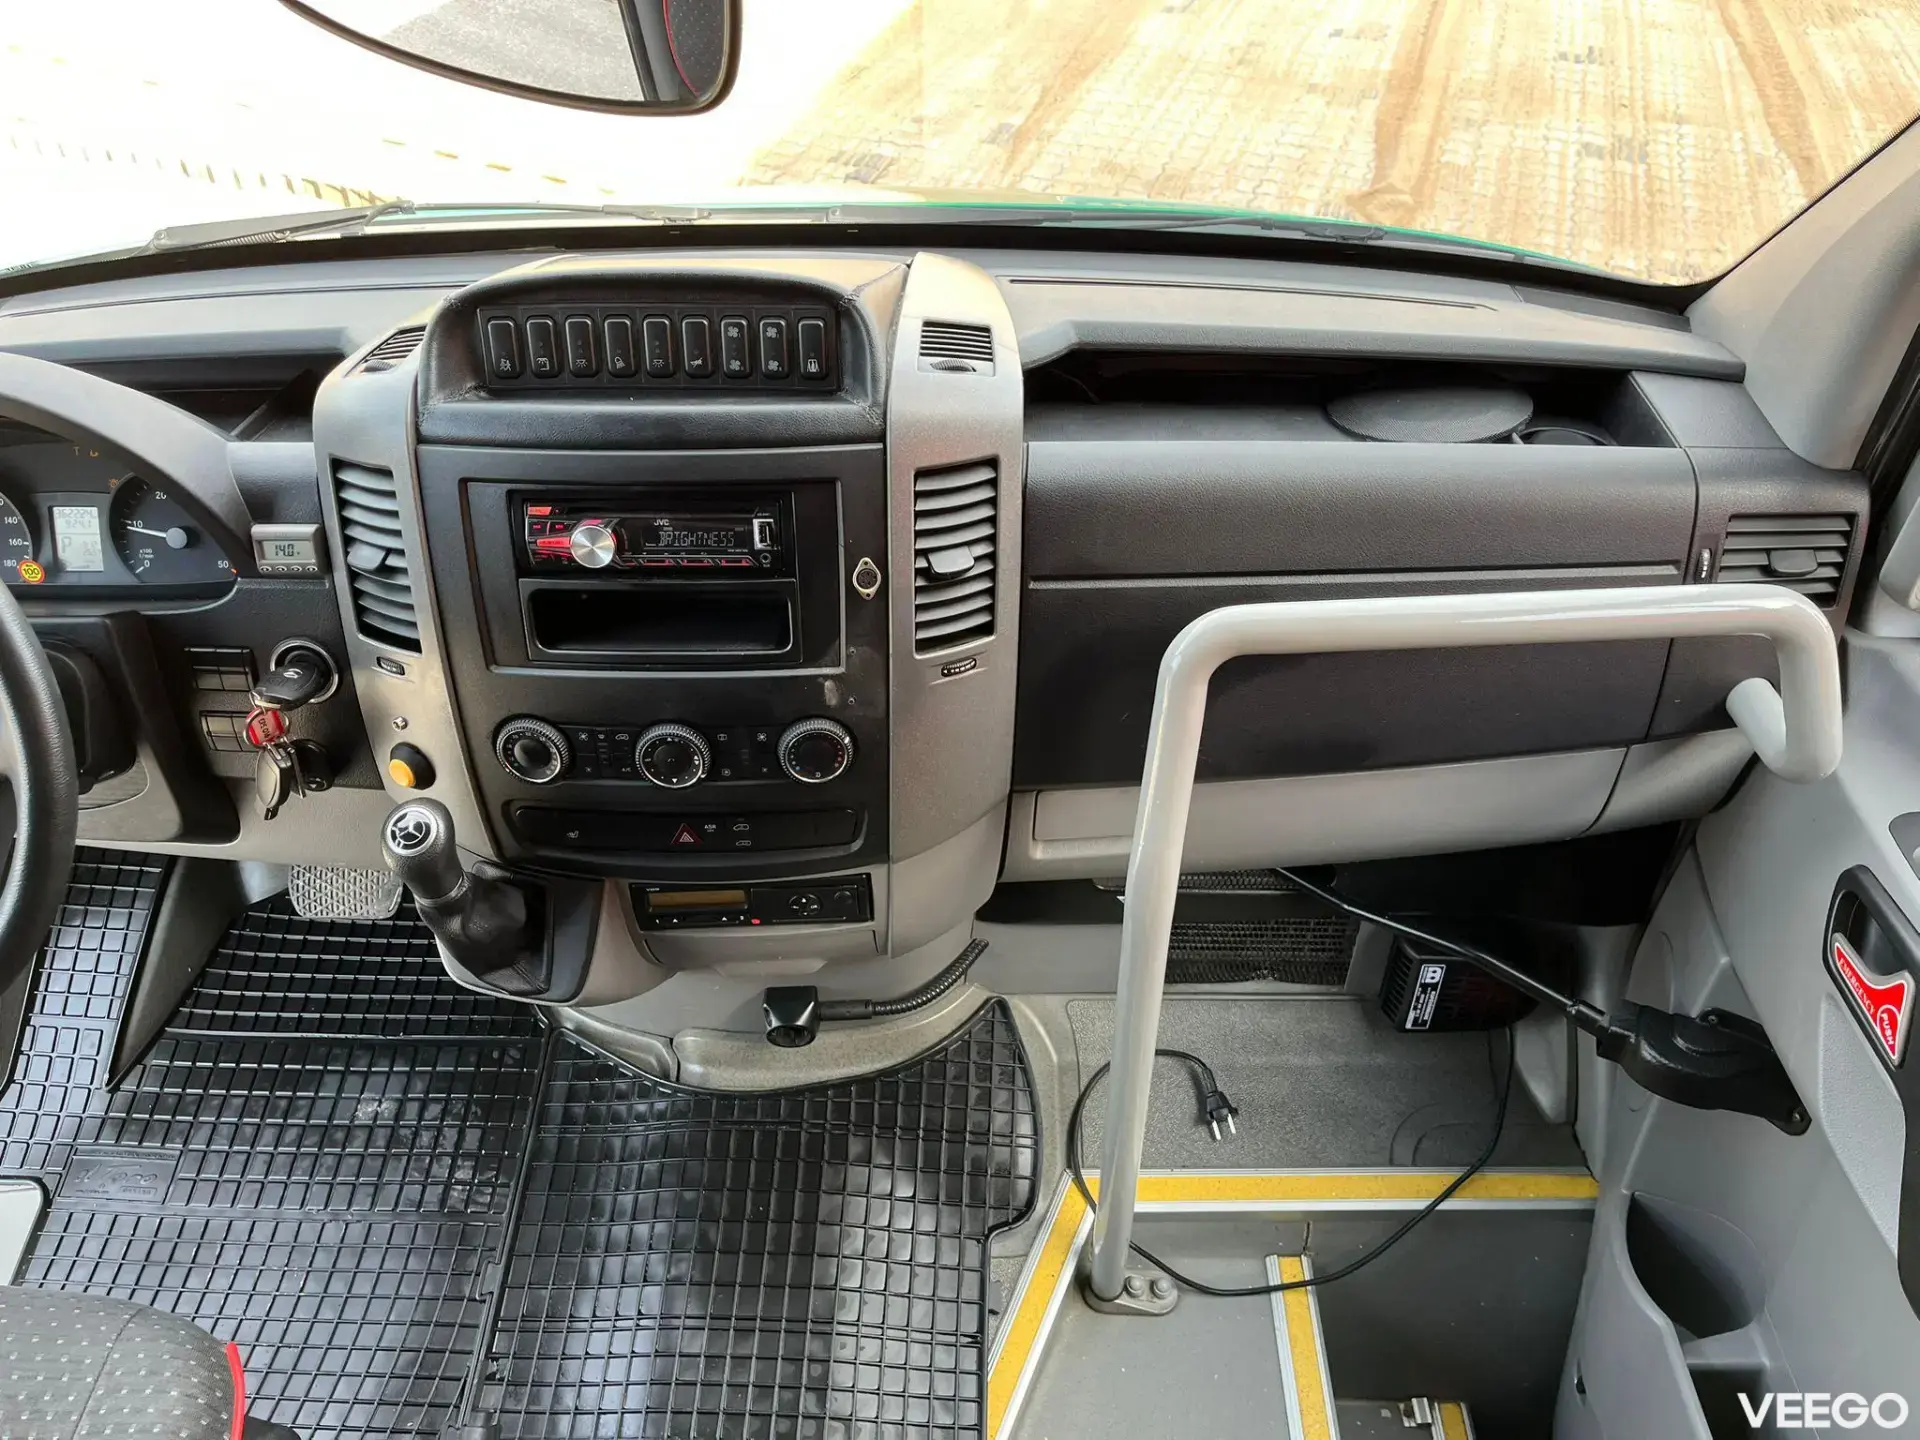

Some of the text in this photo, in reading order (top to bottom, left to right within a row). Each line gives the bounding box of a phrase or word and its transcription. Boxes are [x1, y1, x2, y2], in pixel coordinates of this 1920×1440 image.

[4, 516, 18, 525] 140
[132, 520, 143, 528] 10
[653, 518, 670, 526] JVC
[9, 538, 23, 546] 160
[658, 530, 735, 547] BRIGHTNESS
[3, 559, 17, 567] 180
[144, 560, 150, 568] 0
[217, 560, 229, 569] 50
[22, 567, 40, 576] 100
[1838, 958, 1876, 1015] EMERGENCY
[1880, 1012, 1895, 1046] PUSH
